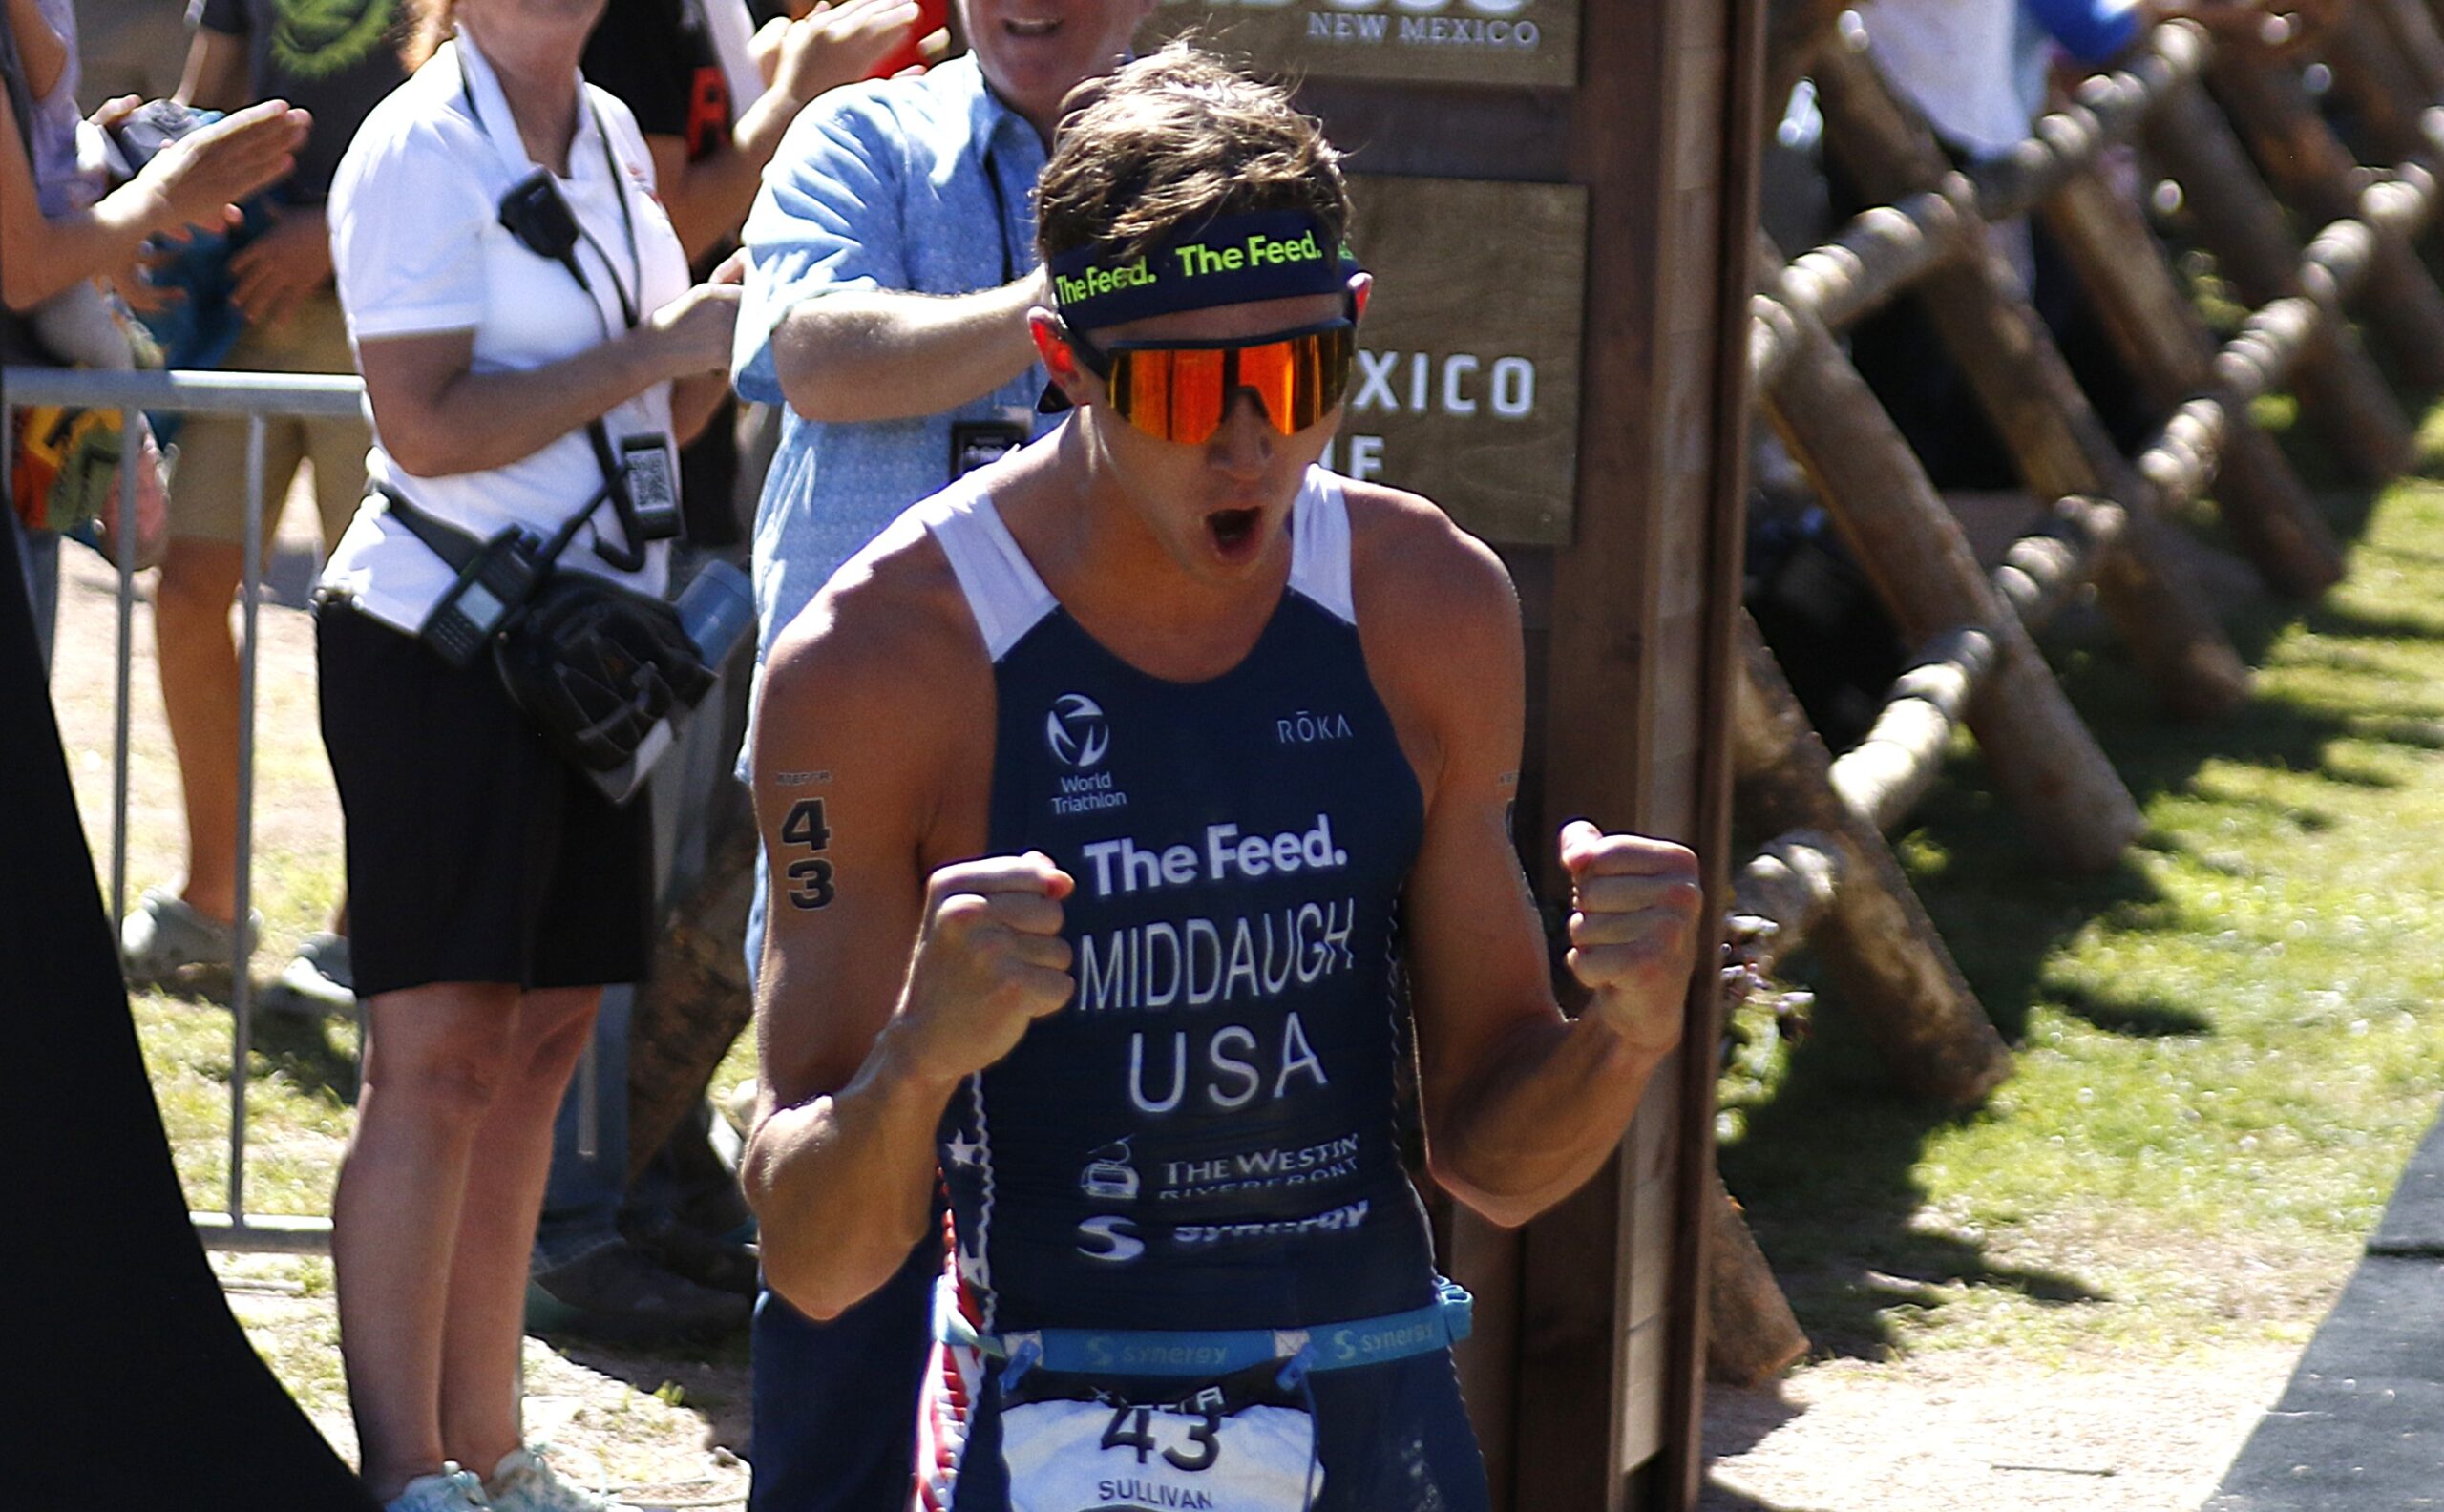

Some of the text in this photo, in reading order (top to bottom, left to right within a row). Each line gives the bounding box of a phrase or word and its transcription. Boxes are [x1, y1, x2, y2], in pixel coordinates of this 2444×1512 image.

[1307, 12, 1540, 49] NEW MEXICO
[1175, 242, 1243, 276] The
[1247, 230, 1322, 266] Feed.
[1055, 255, 1157, 304] The Feed.
[1352, 348, 1536, 416] XICO
[1051, 790, 1127, 816] Triathlon
[1060, 771, 1112, 794] World
[1083, 813, 1348, 896] The Feed.
[1079, 897, 1355, 1011] MIDDAUGH
[1129, 1011, 1330, 1113] USA
[1162, 1133, 1359, 1185] THE WESTIN
[1100, 1398, 1221, 1472] 43
[1098, 1479, 1214, 1510] SULLIVAN
